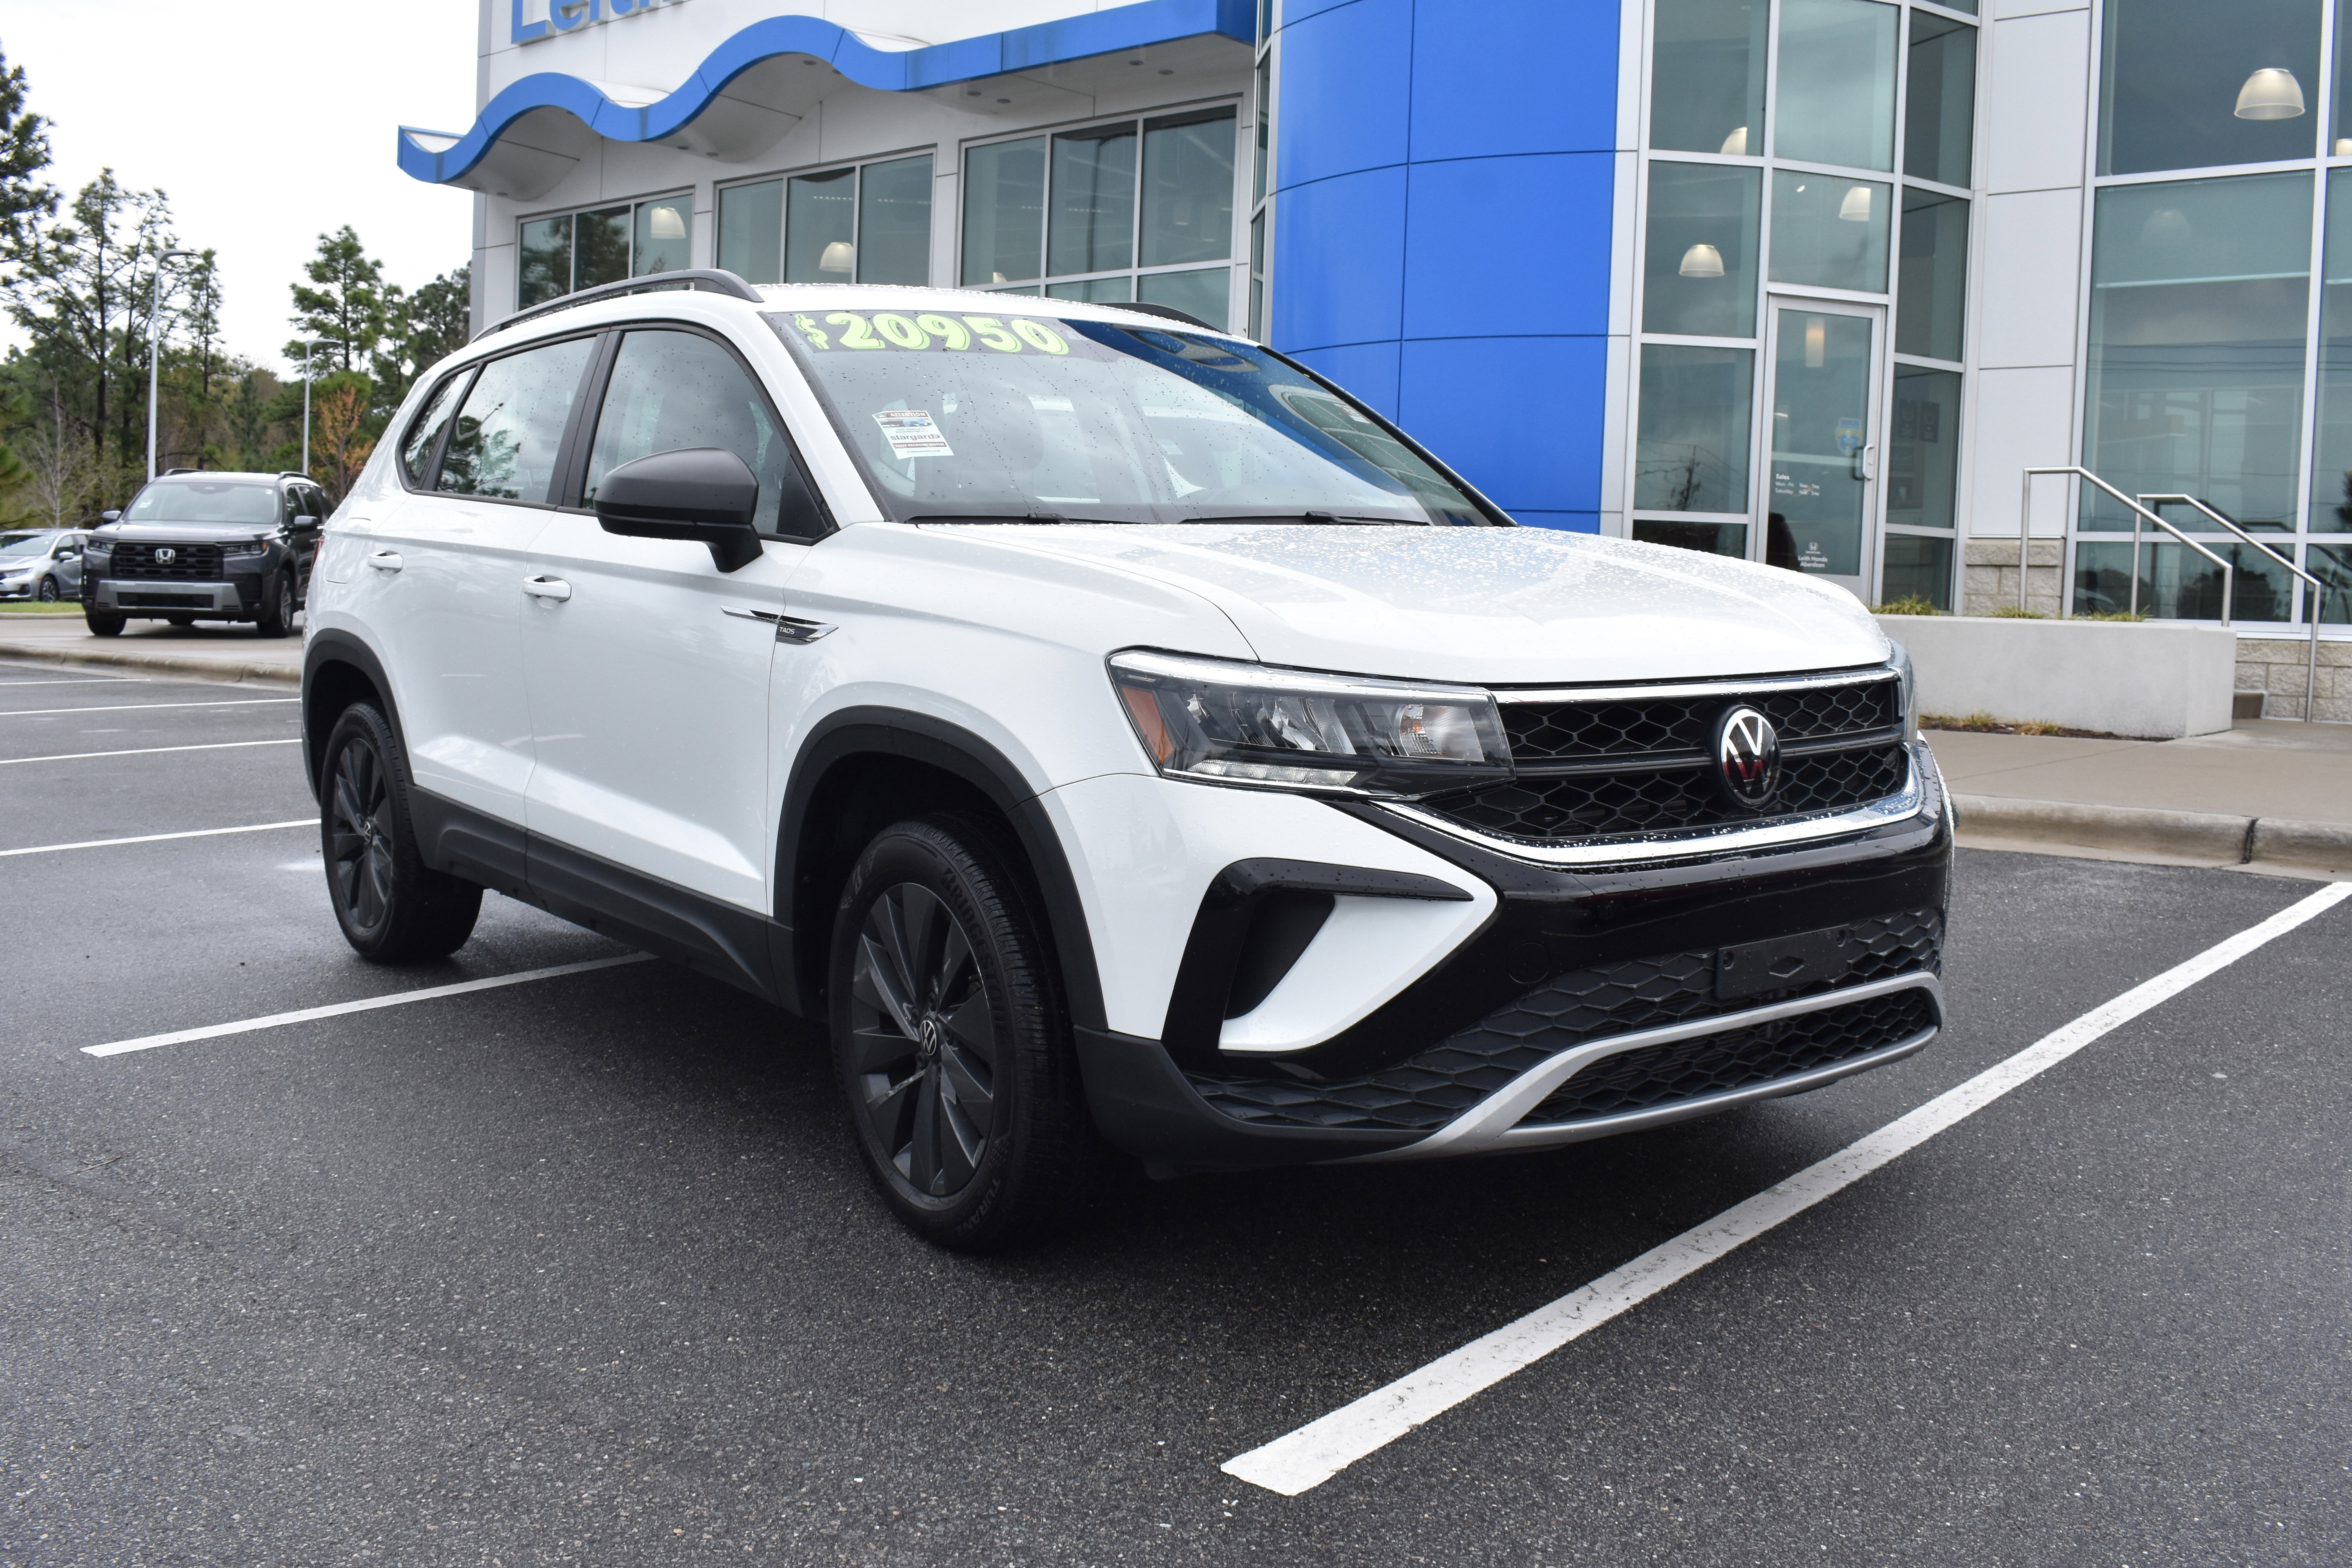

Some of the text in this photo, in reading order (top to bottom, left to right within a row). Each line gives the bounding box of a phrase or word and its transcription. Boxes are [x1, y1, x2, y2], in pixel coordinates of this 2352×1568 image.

[795, 312, 1069, 355] $20950
[940, 867, 1010, 1043] BRIDGESTONE
[949, 1176, 1002, 1234] TURANZ
